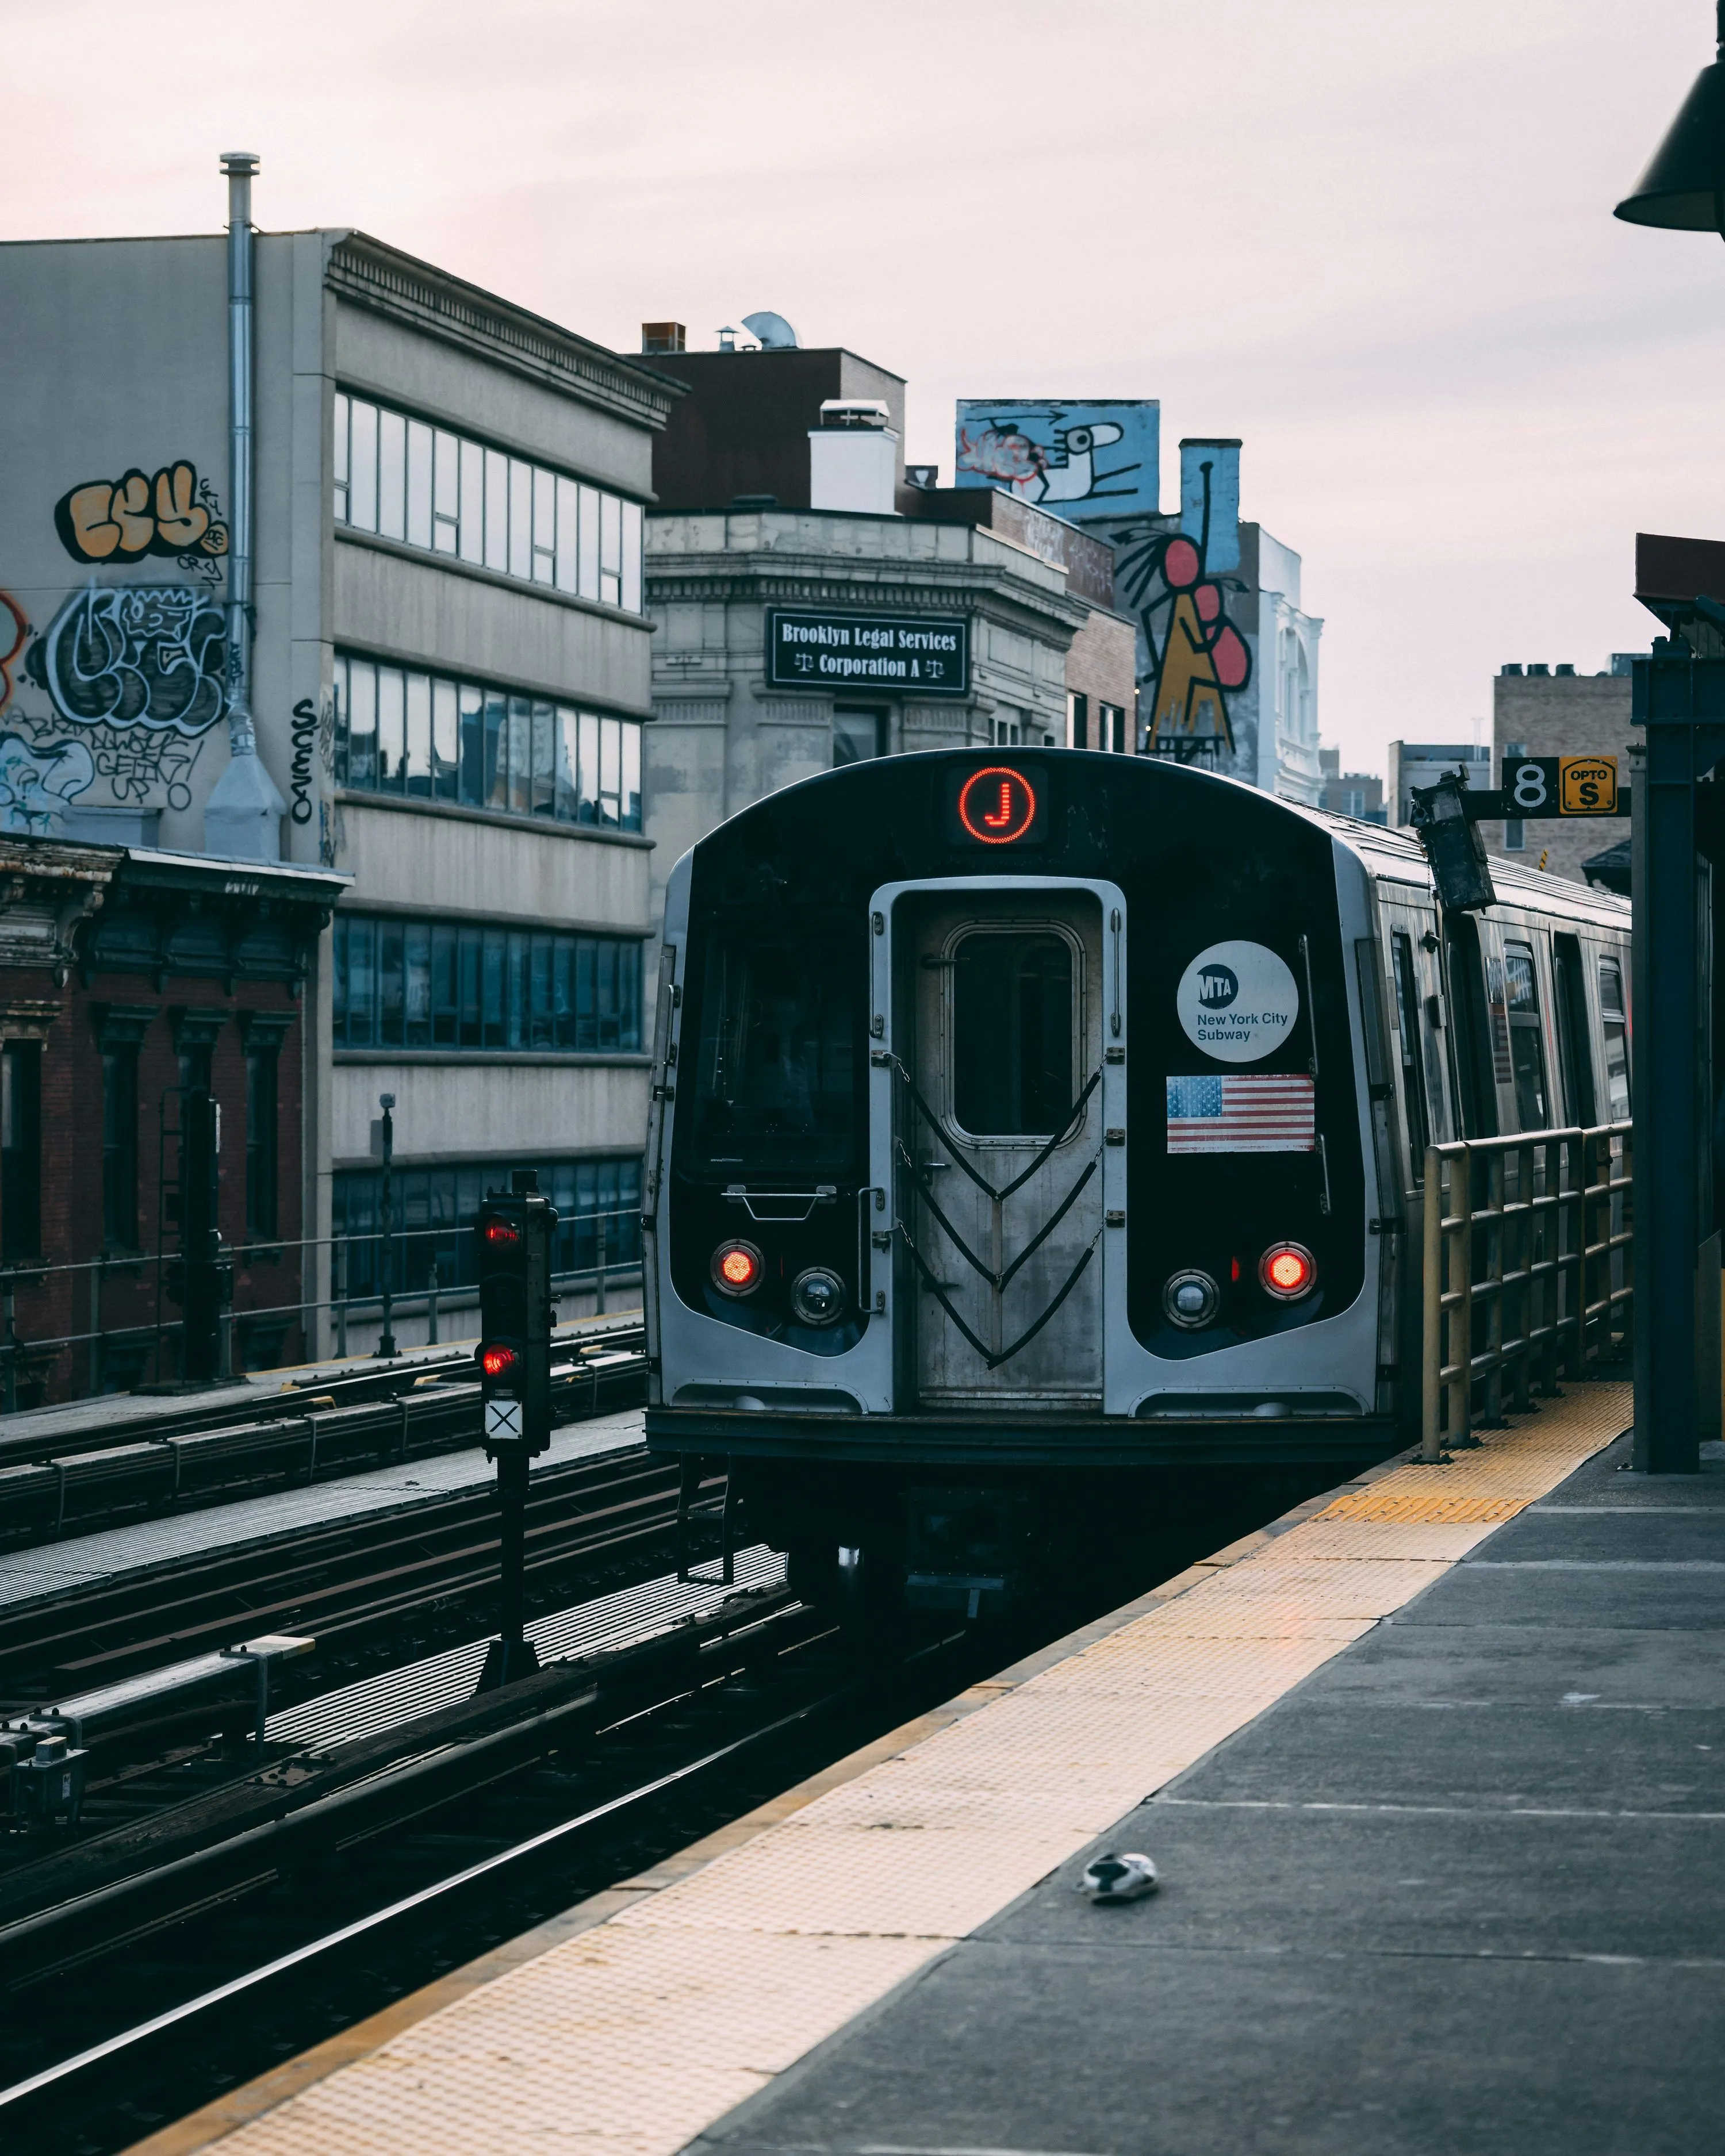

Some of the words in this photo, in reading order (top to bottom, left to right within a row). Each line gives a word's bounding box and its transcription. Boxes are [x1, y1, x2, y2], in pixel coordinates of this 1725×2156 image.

[783, 623, 849, 646] Brooklyn
[854, 627, 894, 649] Legal
[898, 630, 956, 651] Services
[819, 654, 906, 677] Corporation
[910, 658, 919, 677] A
[1514, 764, 1547, 807] 8
[1570, 770, 1608, 781] OPTO
[984, 782, 1010, 827] J
[1579, 782, 1600, 805] S
[1199, 975, 1232, 1000] MTA
[1198, 1014, 1226, 1025] New
[1229, 1014, 1258, 1025] York
[1262, 1012, 1288, 1026] City
[1198, 1029, 1251, 1042] Subway
